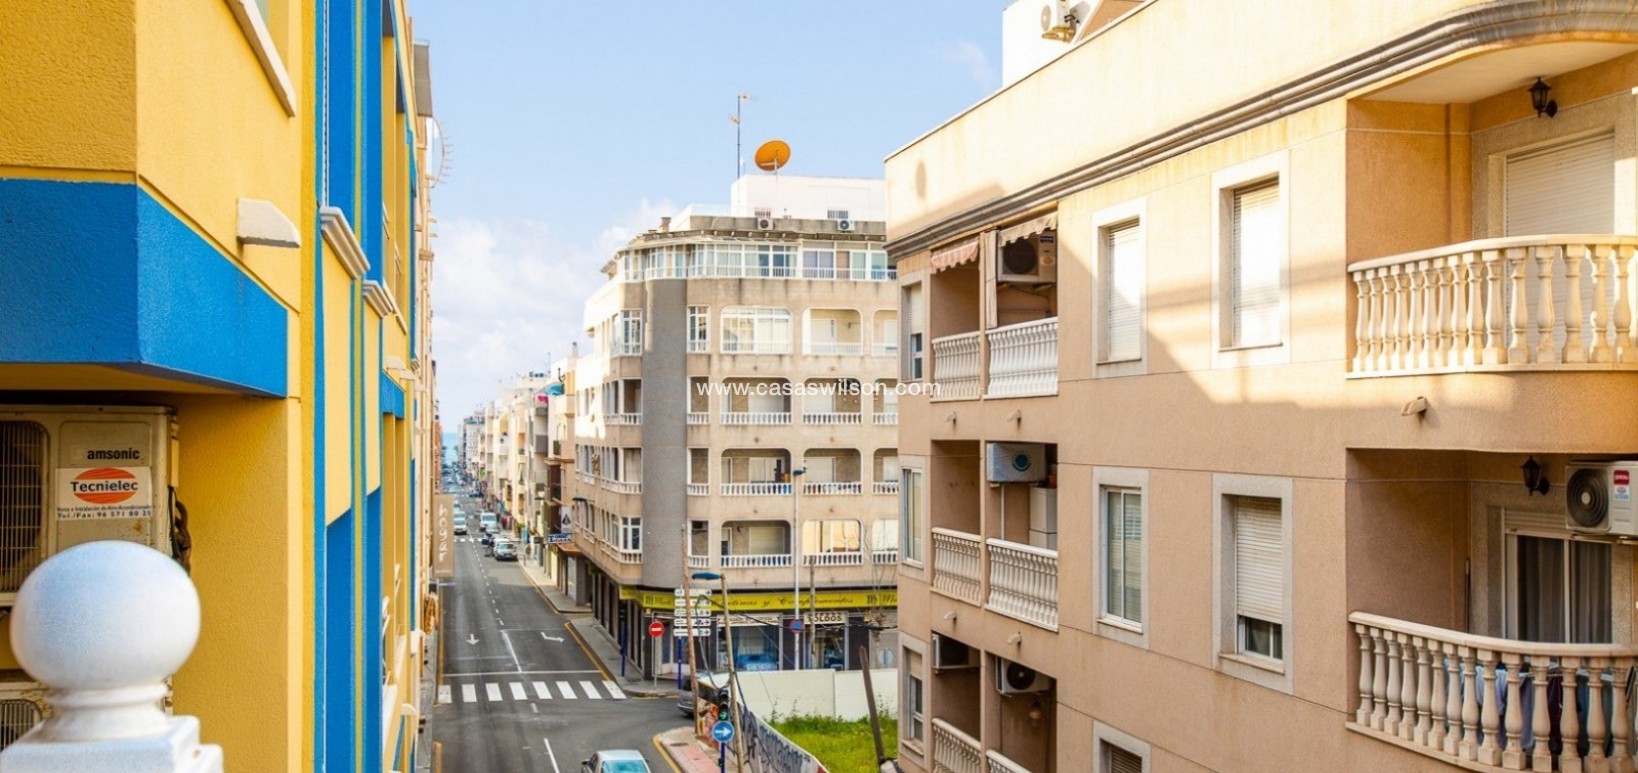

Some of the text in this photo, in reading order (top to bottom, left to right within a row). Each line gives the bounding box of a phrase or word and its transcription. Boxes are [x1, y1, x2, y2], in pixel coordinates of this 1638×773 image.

[87, 447, 140, 460] amsonic
[70, 480, 139, 492] Tecnielec
[777, 596, 854, 606] Coplementos
